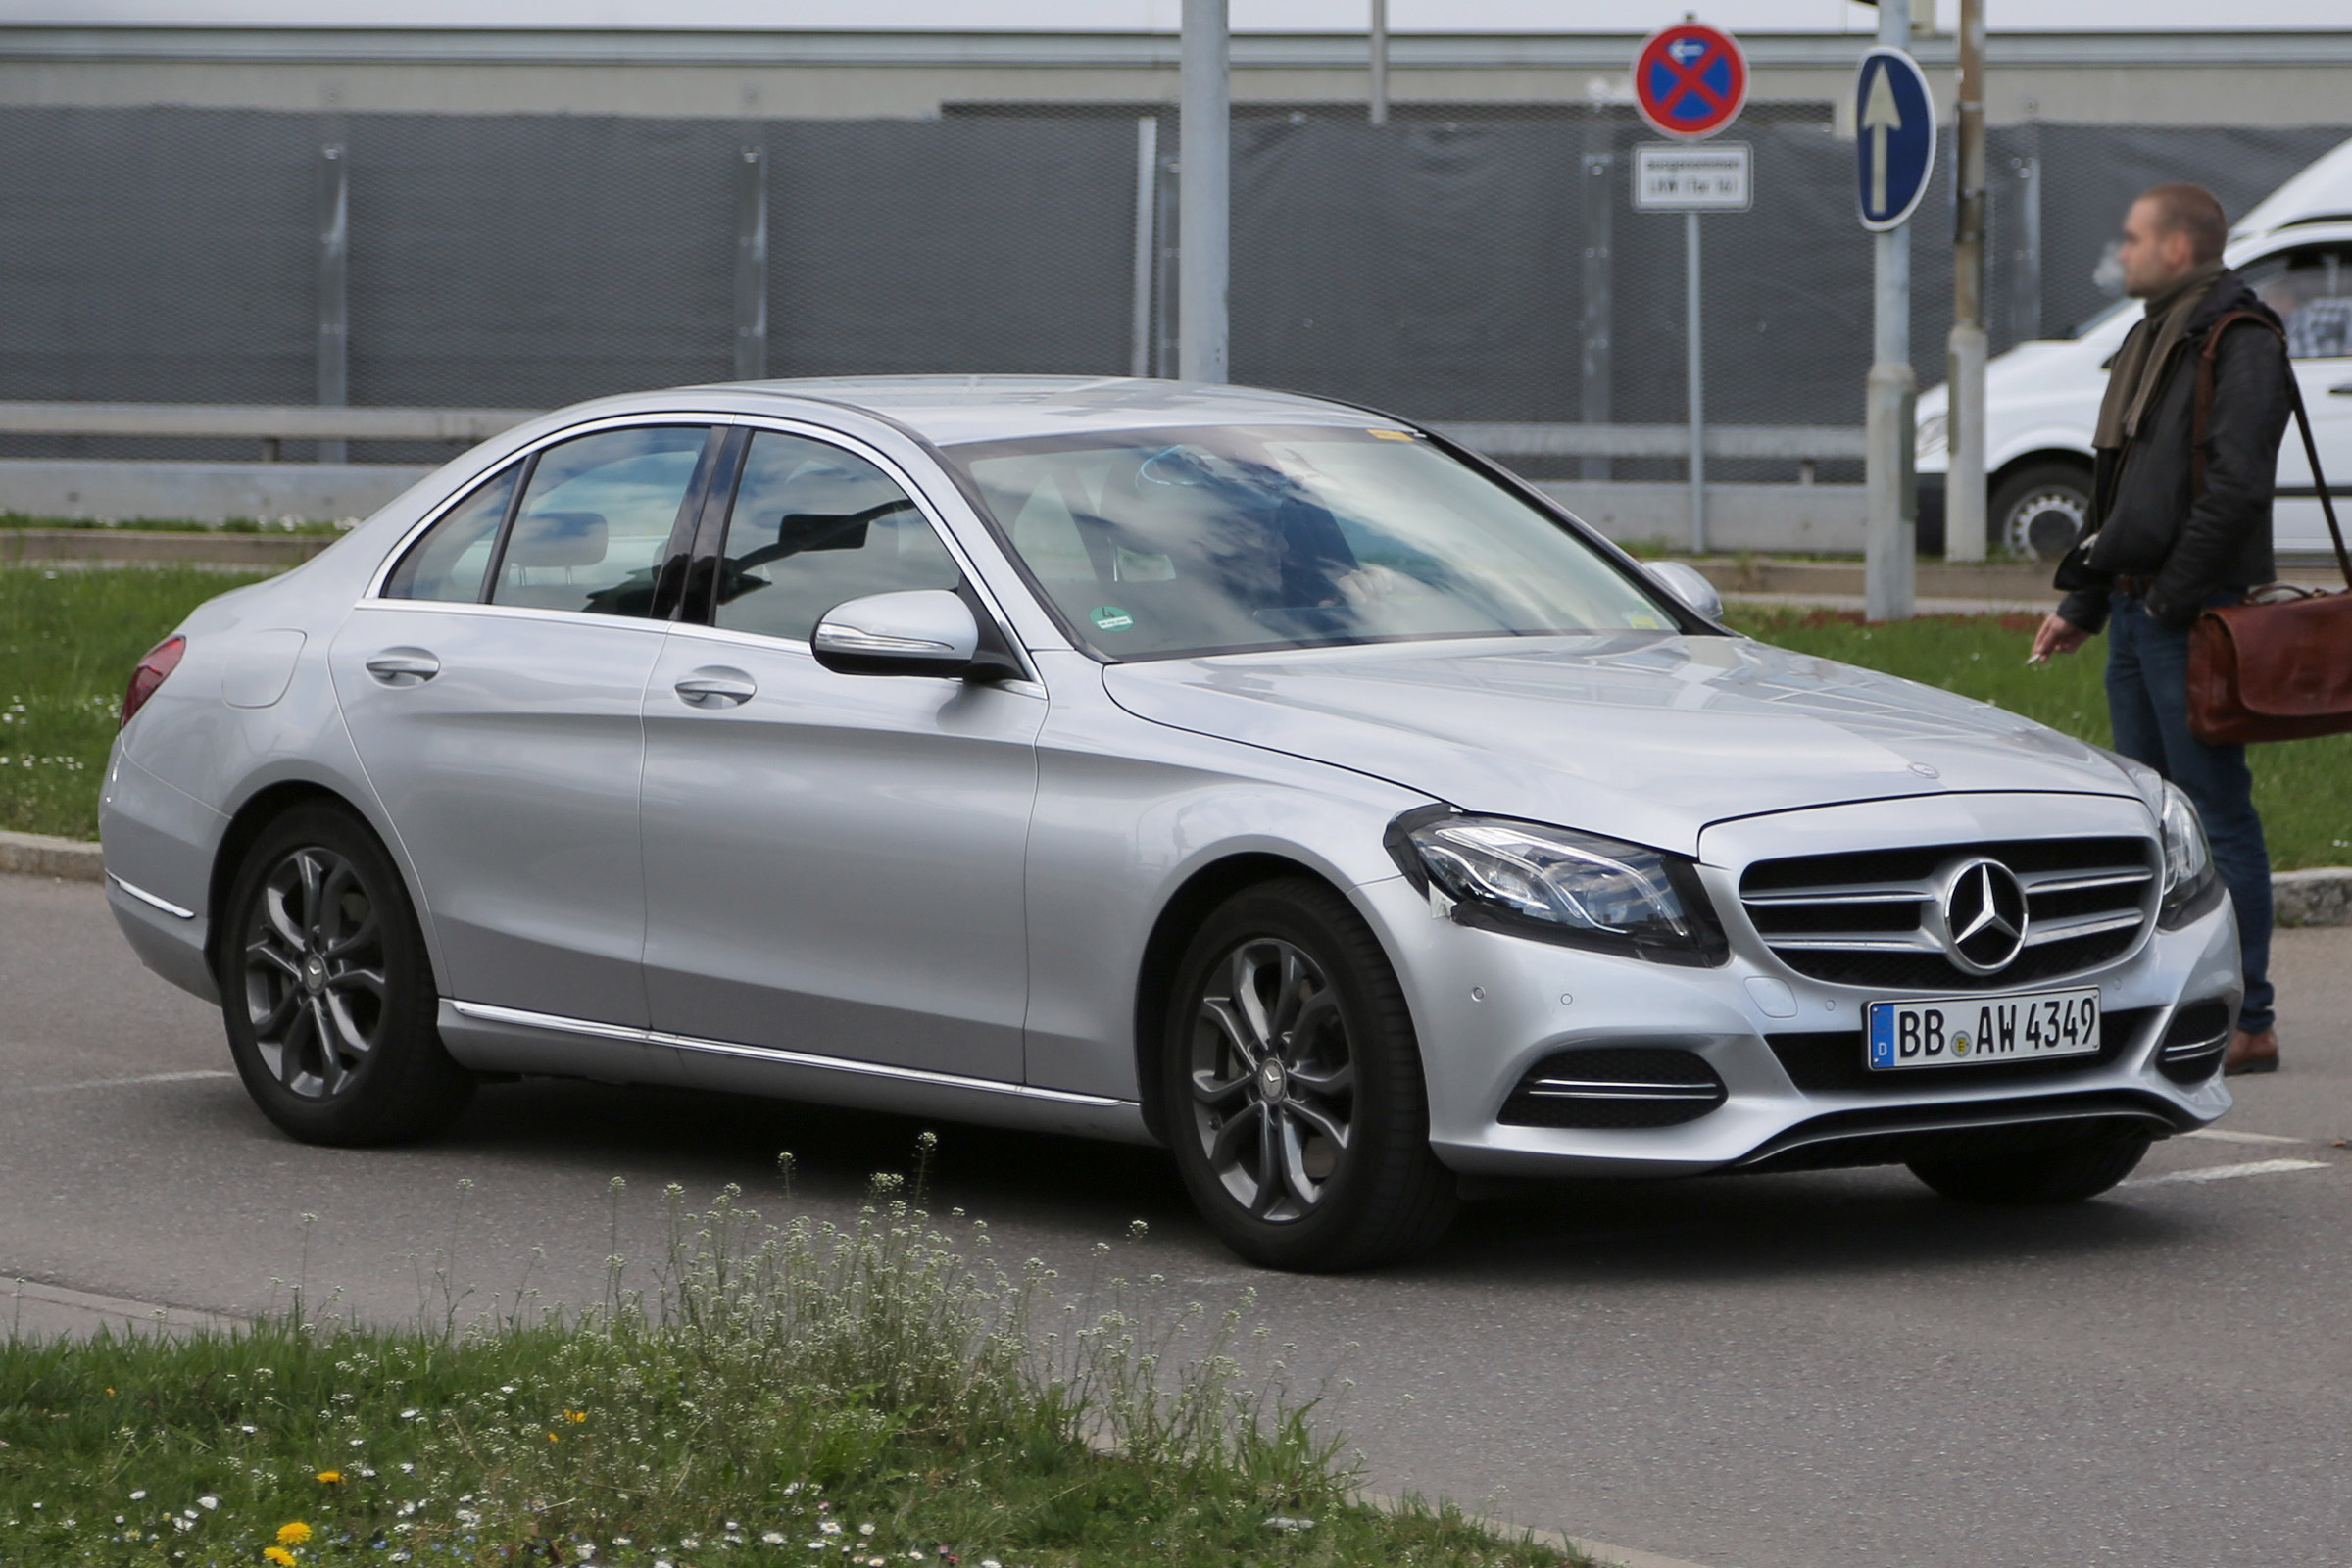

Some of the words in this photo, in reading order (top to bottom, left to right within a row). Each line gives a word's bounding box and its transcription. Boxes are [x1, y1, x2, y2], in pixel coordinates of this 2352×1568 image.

[1899, 1009, 1945, 1058] BB
[1976, 1004, 2017, 1054] AW
[2025, 997, 2096, 1050] 4349
[1878, 1042, 1887, 1056] D
